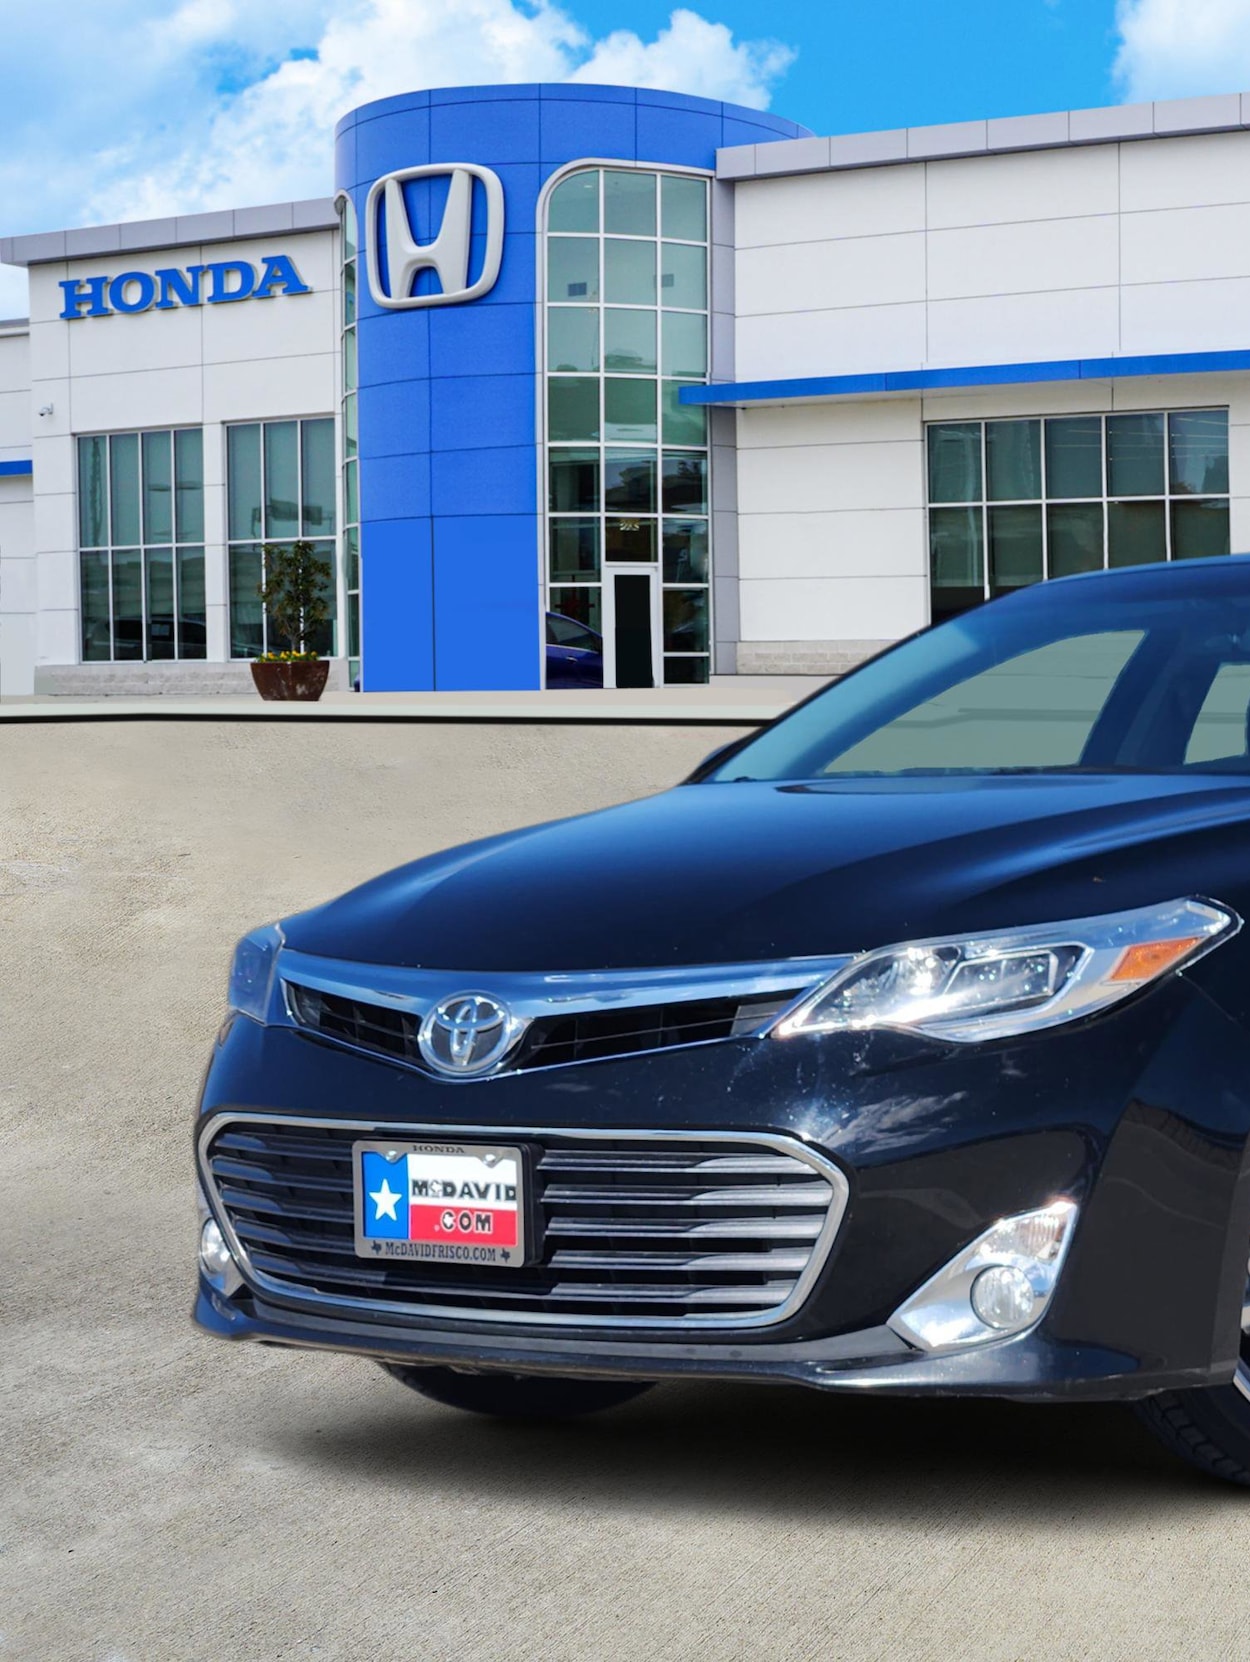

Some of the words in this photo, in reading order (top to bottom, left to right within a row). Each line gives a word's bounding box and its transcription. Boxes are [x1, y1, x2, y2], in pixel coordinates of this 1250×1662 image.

[58, 254, 310, 320] HONDA
[412, 1144, 465, 1154] HONDA
[385, 1241, 496, 1262] McDAVIDFRISCO.COM
